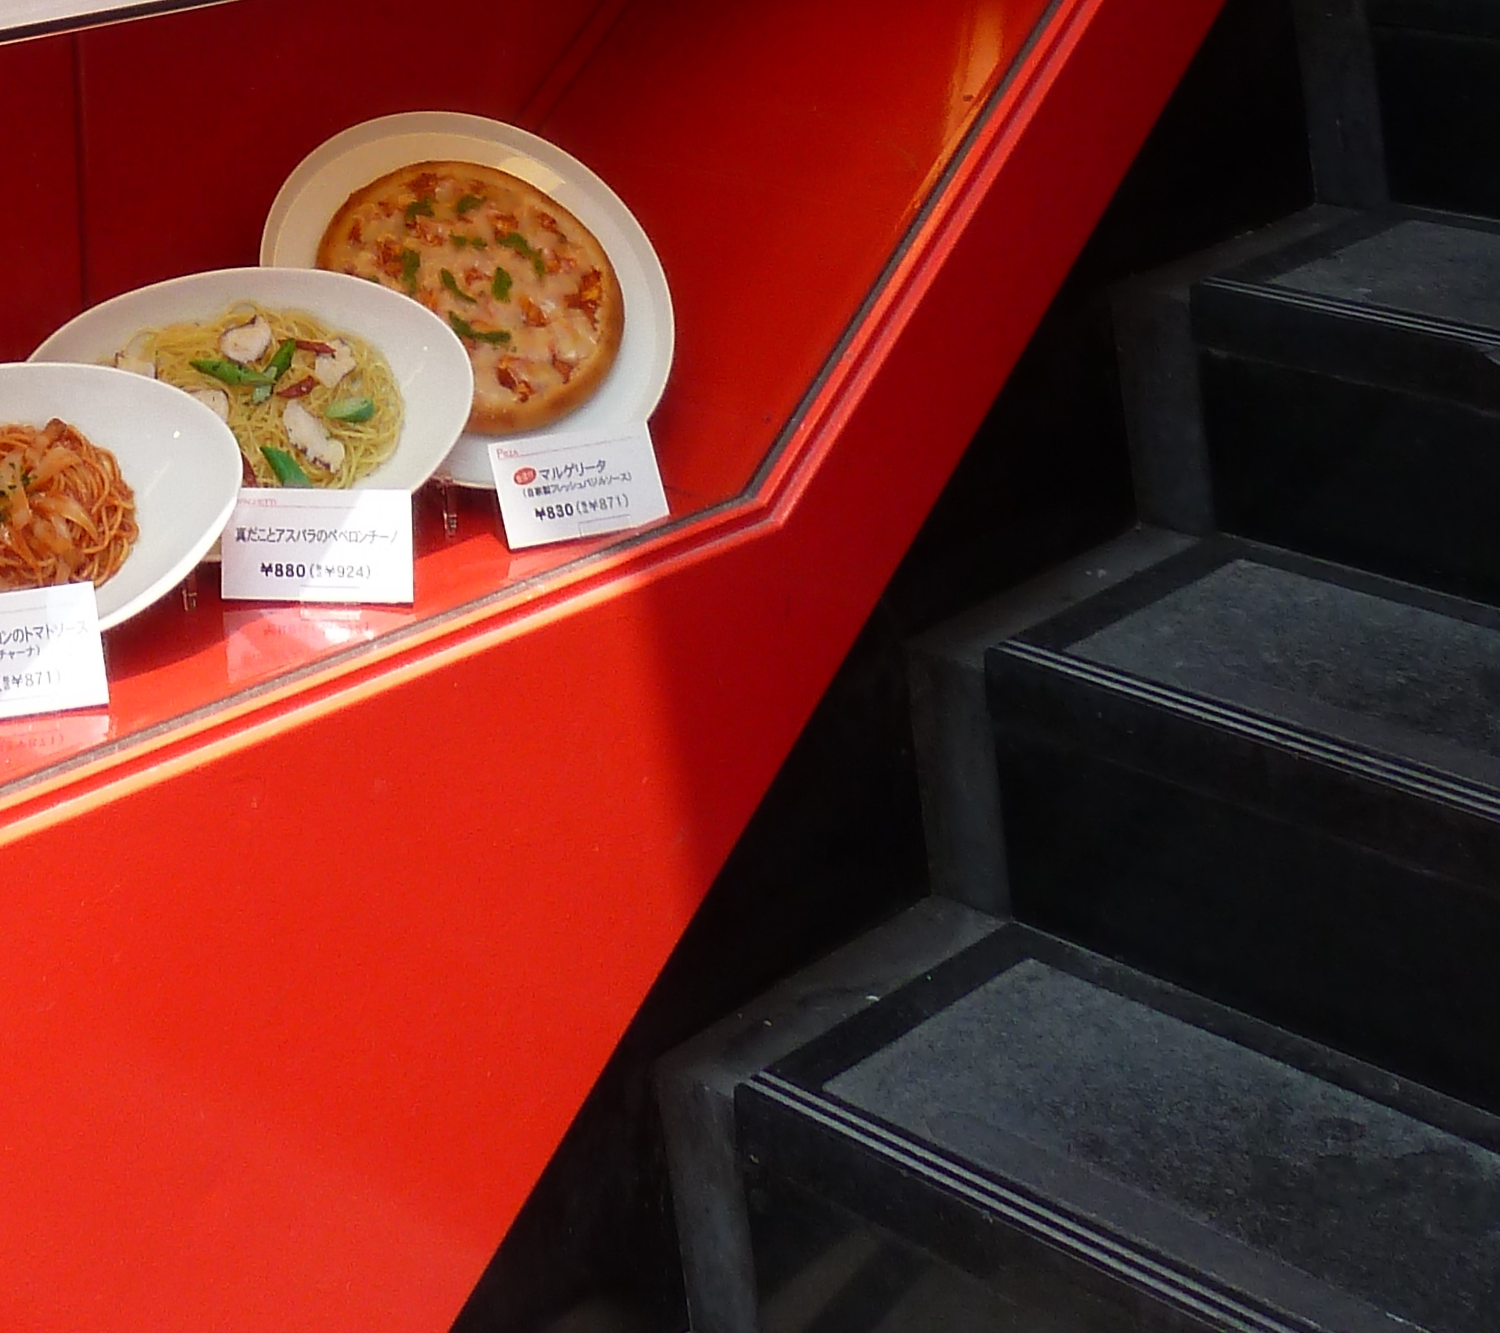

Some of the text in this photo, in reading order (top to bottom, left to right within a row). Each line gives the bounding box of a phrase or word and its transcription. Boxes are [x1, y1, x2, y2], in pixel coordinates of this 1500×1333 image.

[538, 459, 607, 482] マルゲリータ
[534, 502, 574, 522] ¥830
[260, 562, 306, 579] ¥880
